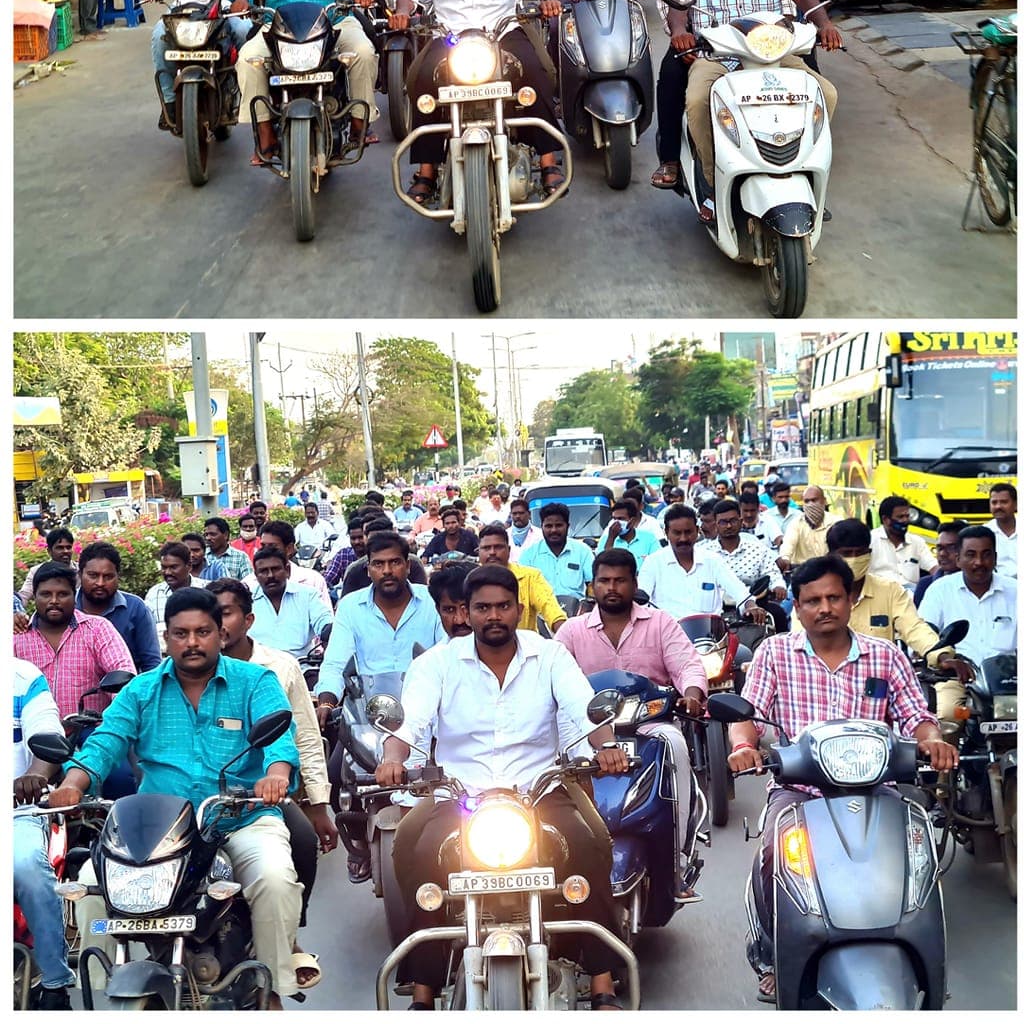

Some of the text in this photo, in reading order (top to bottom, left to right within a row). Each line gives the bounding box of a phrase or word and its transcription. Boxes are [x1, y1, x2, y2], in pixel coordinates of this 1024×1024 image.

[741, 95, 751, 103] AP
[927, 361, 963, 371] Tickets
[964, 360, 997, 369] Online
